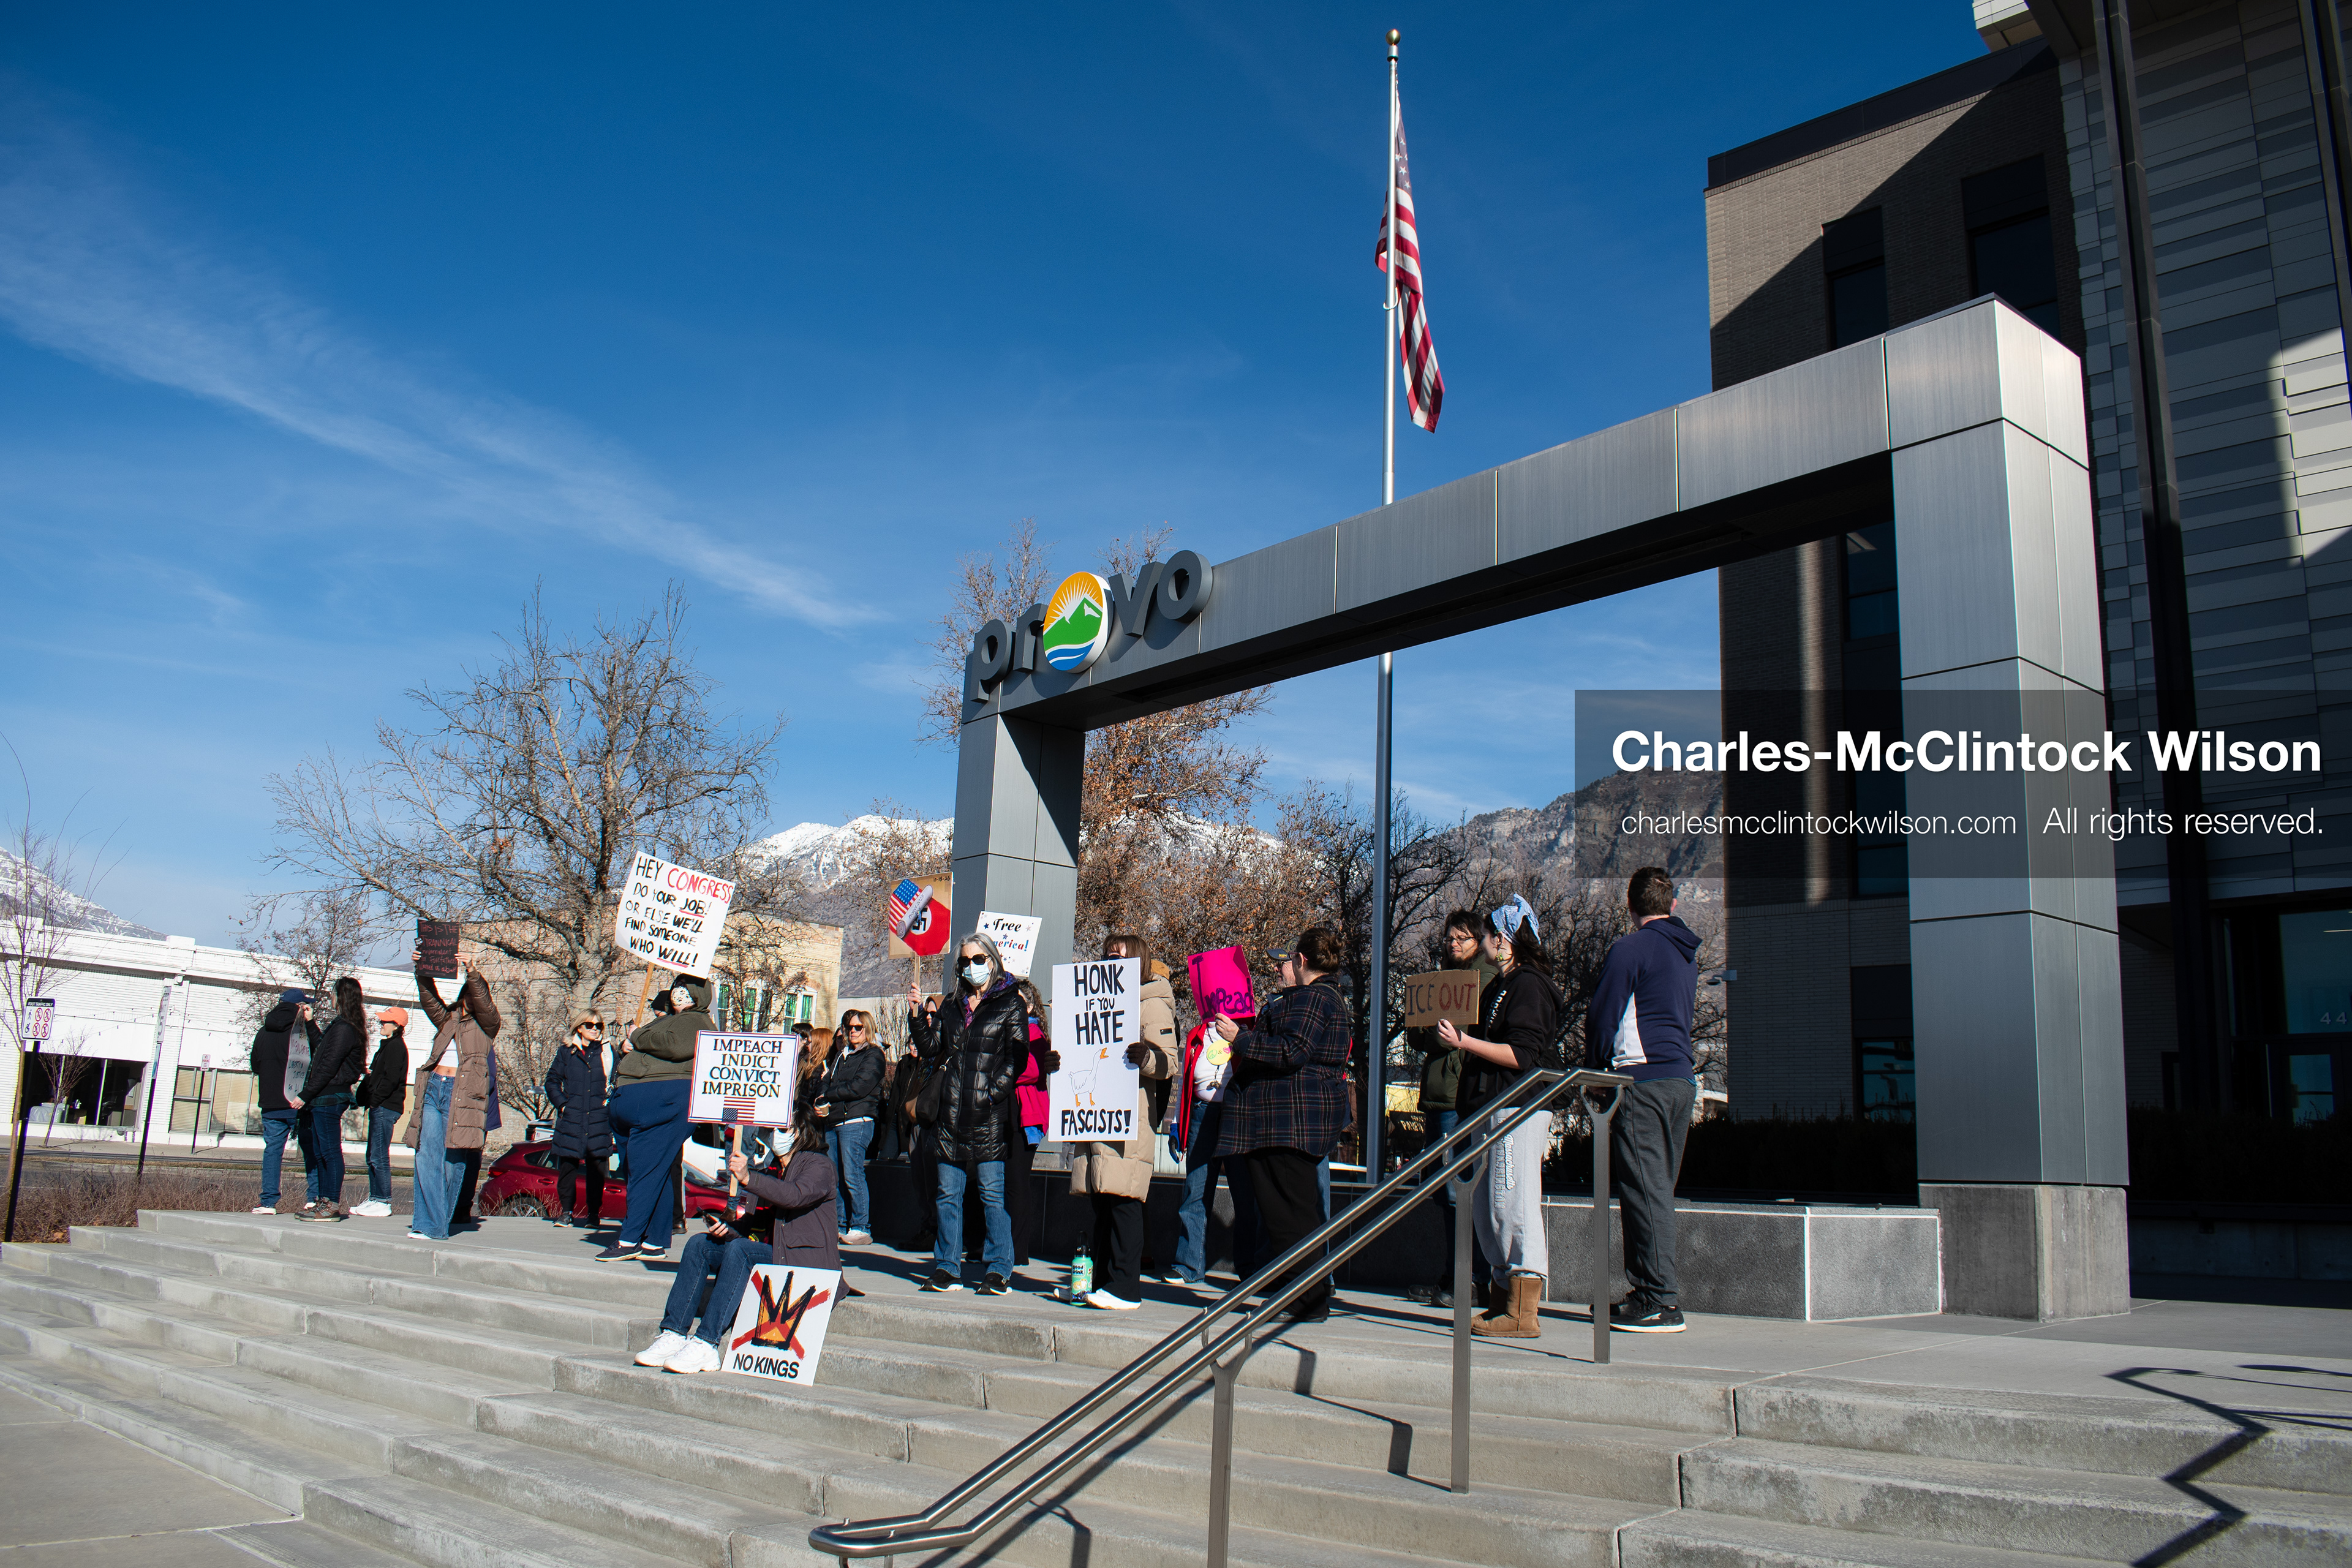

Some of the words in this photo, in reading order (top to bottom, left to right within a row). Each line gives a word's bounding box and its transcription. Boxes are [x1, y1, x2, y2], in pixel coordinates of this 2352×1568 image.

[970, 550, 1213, 703] provo
[636, 856, 664, 881] HEY
[668, 868, 734, 903] CONGRESS
[633, 882, 648, 897] DO
[652, 889, 677, 907] YOUR
[680, 898, 712, 915] JOB!
[418, 921, 433, 932] THIS
[434, 925, 444, 935] IS
[442, 923, 458, 935] THE
[625, 900, 640, 914] OR
[644, 907, 671, 924] ELSE
[673, 915, 704, 933] WE'LL
[625, 917, 646, 932] FIND
[630, 936, 654, 954] WHO
[658, 945, 699, 968] WILL!
[1074, 963, 1125, 997] HONK
[1086, 999, 1095, 1011] IF
[1097, 997, 1115, 1011] YOU
[1407, 983, 1434, 1016] ICE
[1439, 982, 1476, 1012] OUT
[1076, 1010, 1125, 1045] HATE
[713, 1038, 783, 1054] IMPEACH
[709, 1066, 780, 1084] CONVICT
[721, 1054, 778, 1068] INDICT
[702, 1080, 781, 1098] IMPRISON
[1061, 1109, 1131, 1136] FASCISTS!
[1502, 1134, 1516, 1190] Massachusetts
[733, 1353, 754, 1371] NO
[753, 1355, 800, 1379] KINGS
